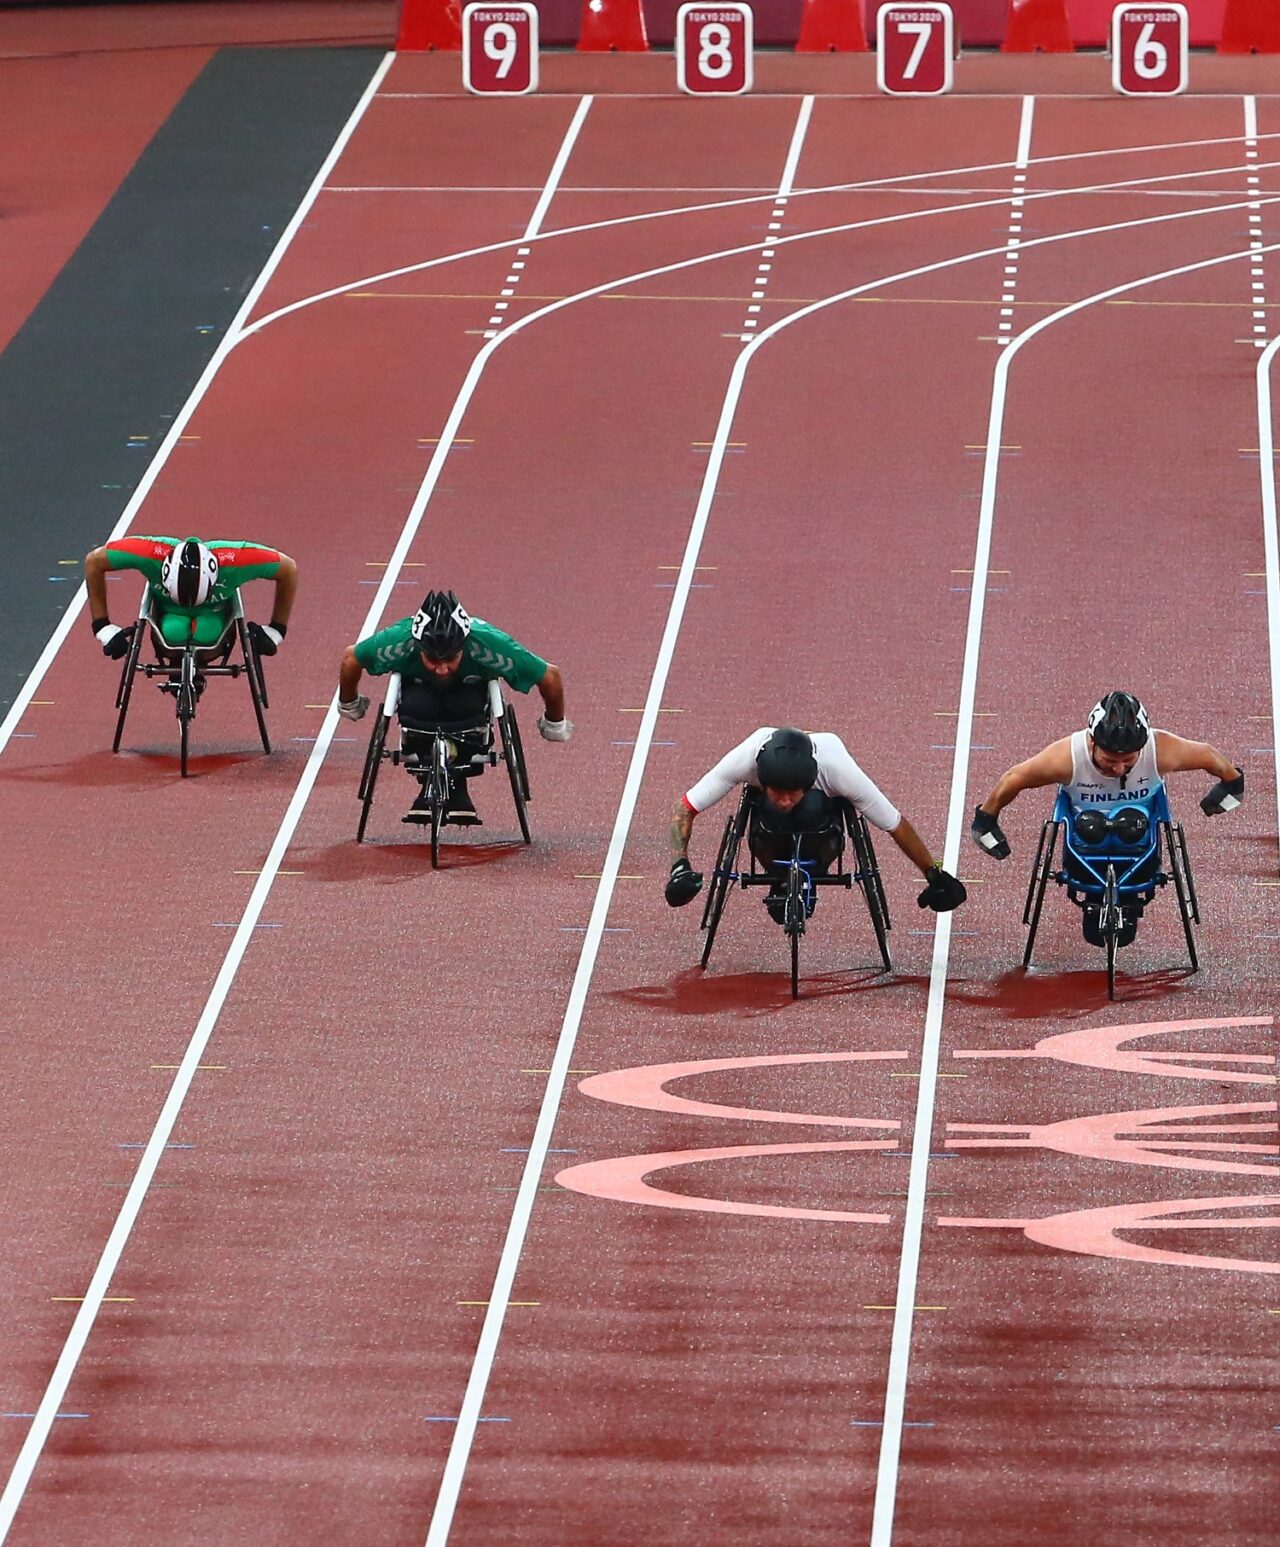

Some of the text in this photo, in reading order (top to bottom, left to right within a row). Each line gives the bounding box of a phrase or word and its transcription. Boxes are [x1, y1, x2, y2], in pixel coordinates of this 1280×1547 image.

[473, 12, 527, 21] TOKYO 2020
[689, 12, 742, 21] TOKYO 2020
[889, 12, 942, 21] TOKYO 2020
[1124, 13, 1178, 22] TOKYO 2020
[483, 22, 517, 78] 9
[698, 22, 733, 78] 8
[897, 23, 932, 78] 7
[1133, 23, 1168, 79] 6
[1081, 788, 1149, 802] FINLAND
